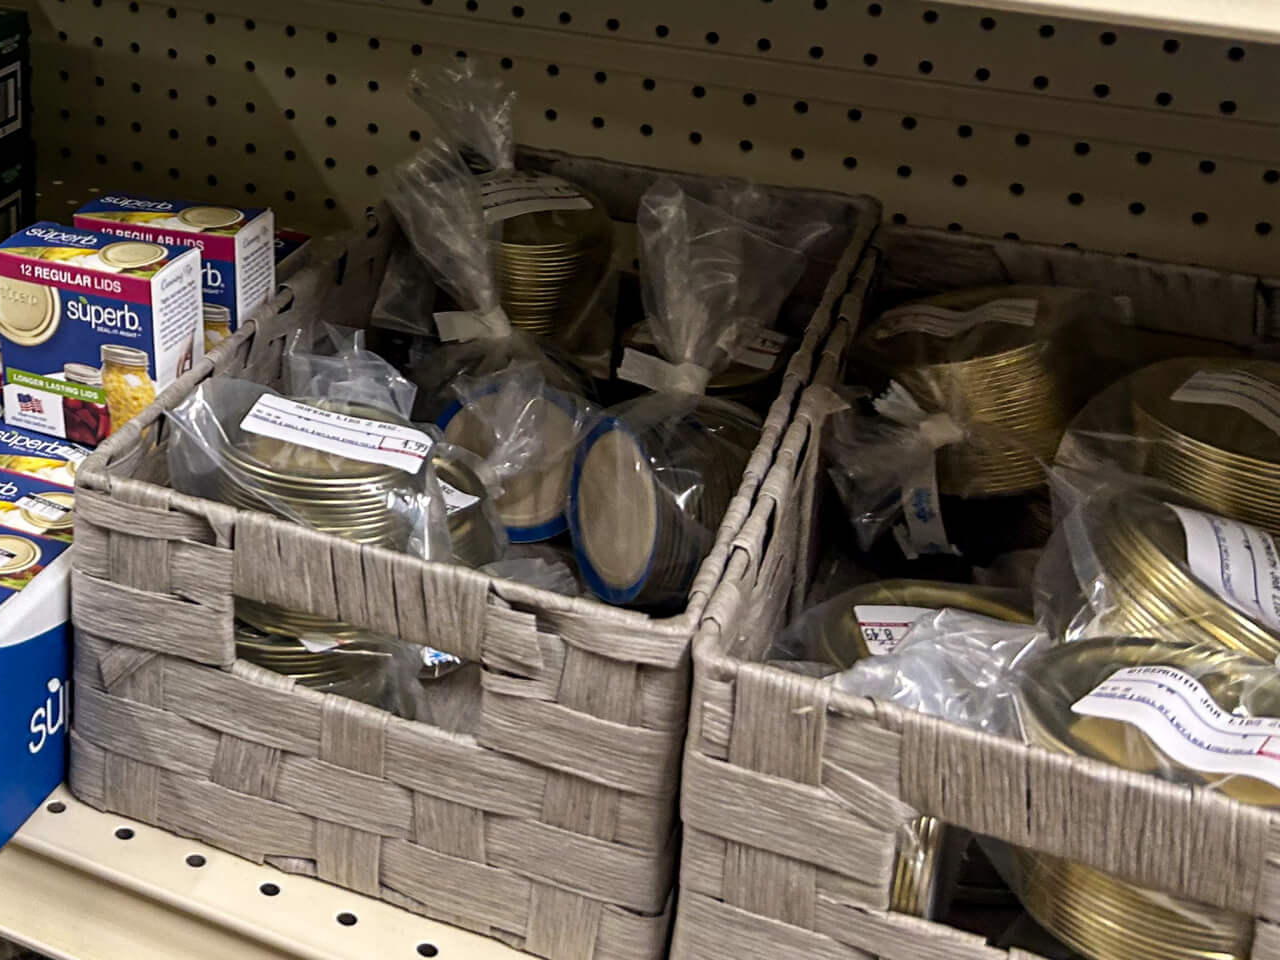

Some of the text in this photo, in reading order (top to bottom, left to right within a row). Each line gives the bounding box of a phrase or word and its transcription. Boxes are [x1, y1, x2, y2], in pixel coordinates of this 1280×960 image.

[100, 195, 173, 211] superb
[25, 227, 98, 246] superb
[20, 263, 122, 293] 12 REGULAR LIDS
[67, 298, 141, 332] superb
[13, 373, 44, 387] LONGER
